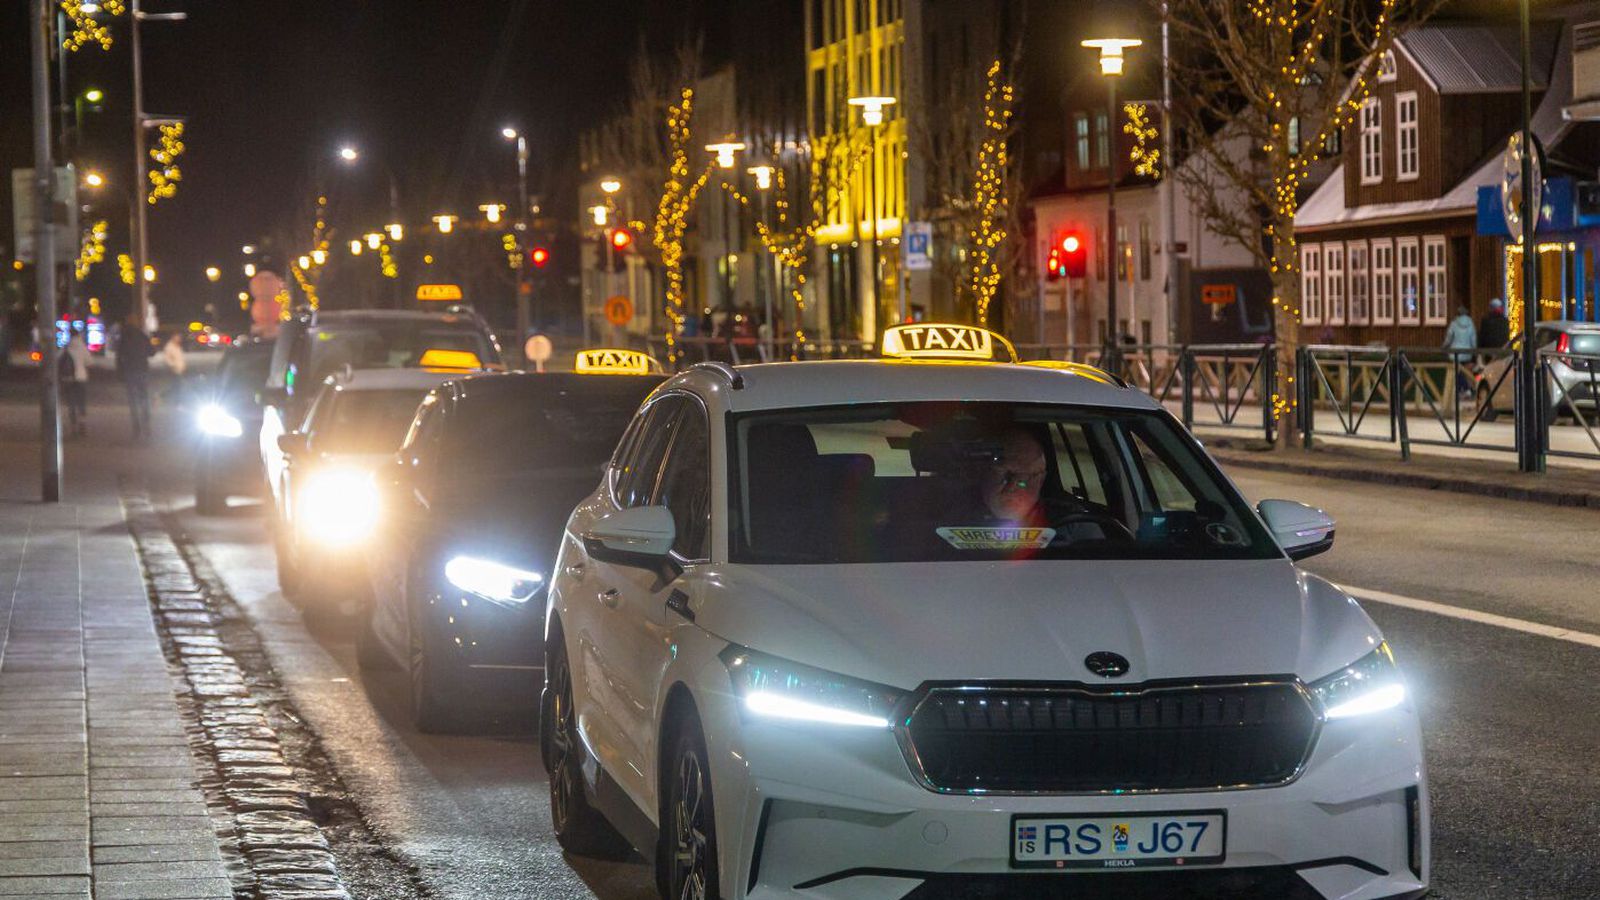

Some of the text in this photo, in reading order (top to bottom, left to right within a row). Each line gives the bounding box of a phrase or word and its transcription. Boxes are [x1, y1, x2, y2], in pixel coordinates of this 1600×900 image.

[902, 327, 980, 351] TAXI
[588, 352, 639, 366] TAXI
[1045, 823, 1101, 855] RS
[1138, 822, 1209, 854] J67
[1019, 841, 1036, 854] IS
[1104, 859, 1136, 867] HEKLA
